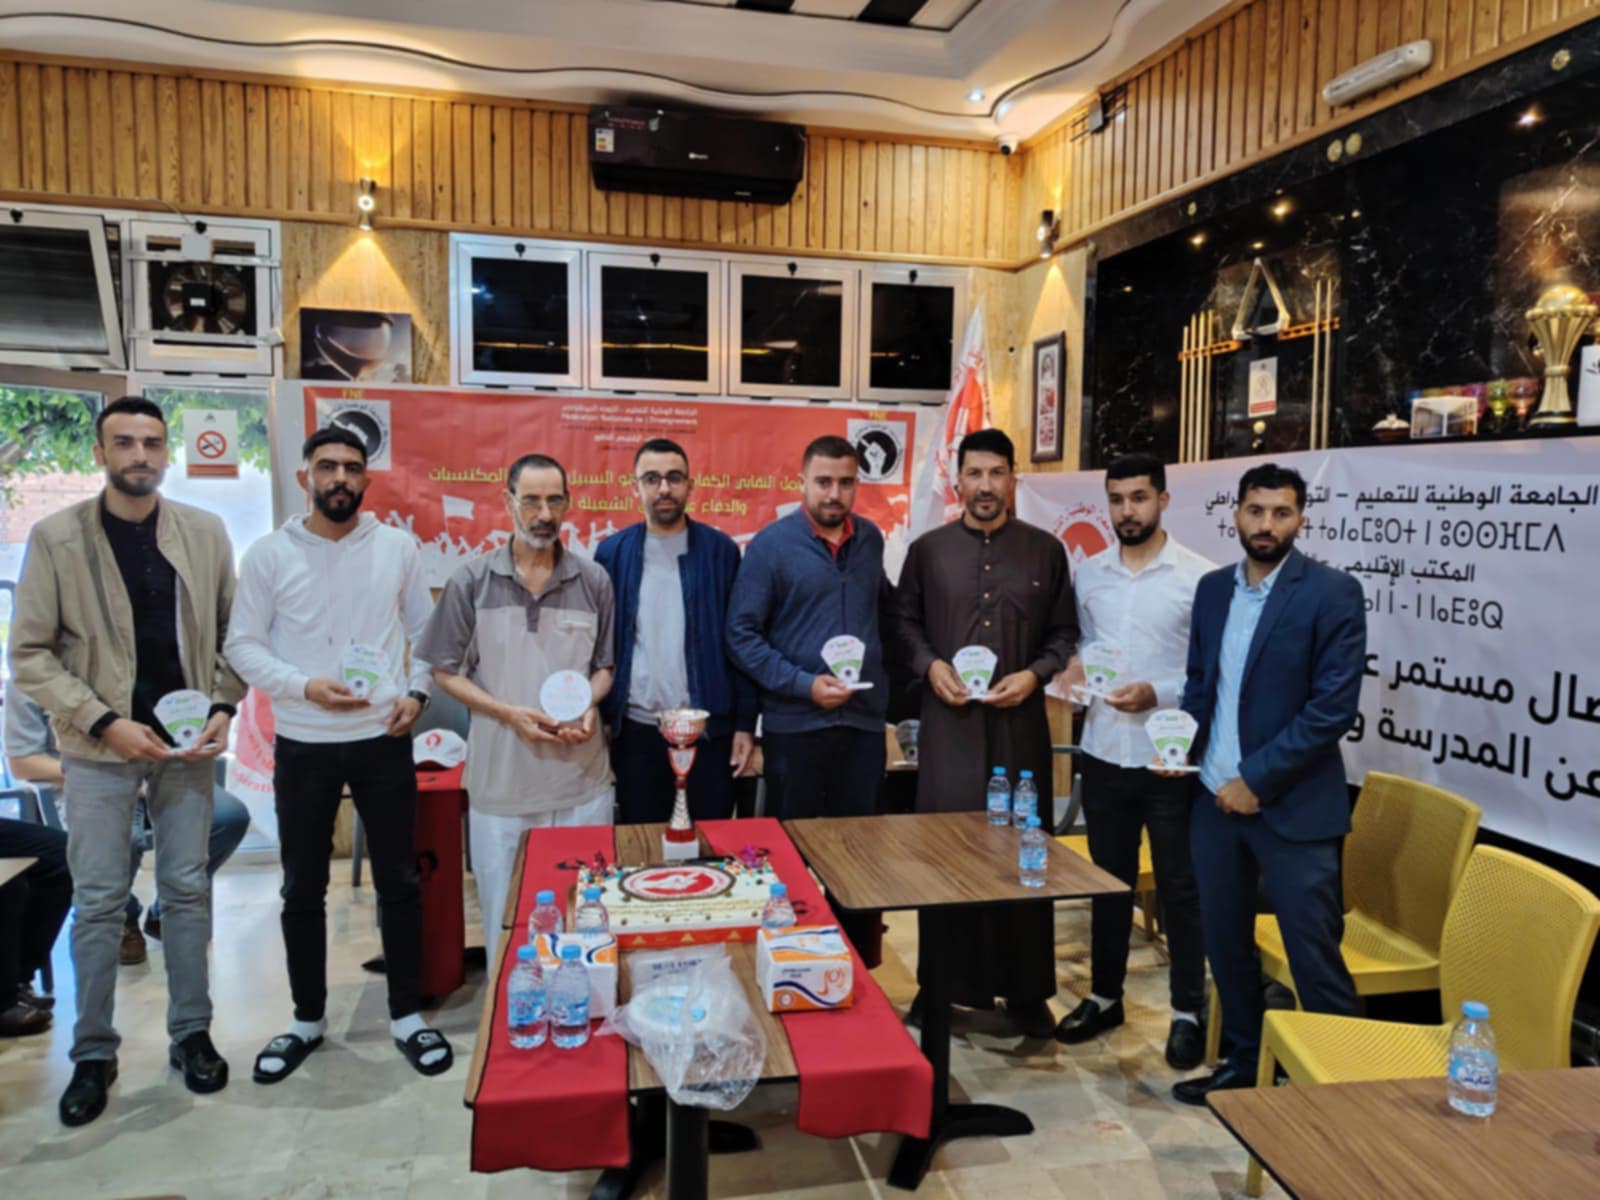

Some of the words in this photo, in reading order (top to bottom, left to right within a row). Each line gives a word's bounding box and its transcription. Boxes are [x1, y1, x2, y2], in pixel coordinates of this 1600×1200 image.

[1305, 486, 1331, 508] التو
[1355, 485, 1420, 511] للتعليم
[1425, 484, 1502, 511] الوطنية
[1509, 484, 1598, 513] الجامعة
[1410, 559, 1475, 584] المكتب
[1388, 656, 1515, 704] مستمر
[1376, 706, 1531, 779] المدرسة
